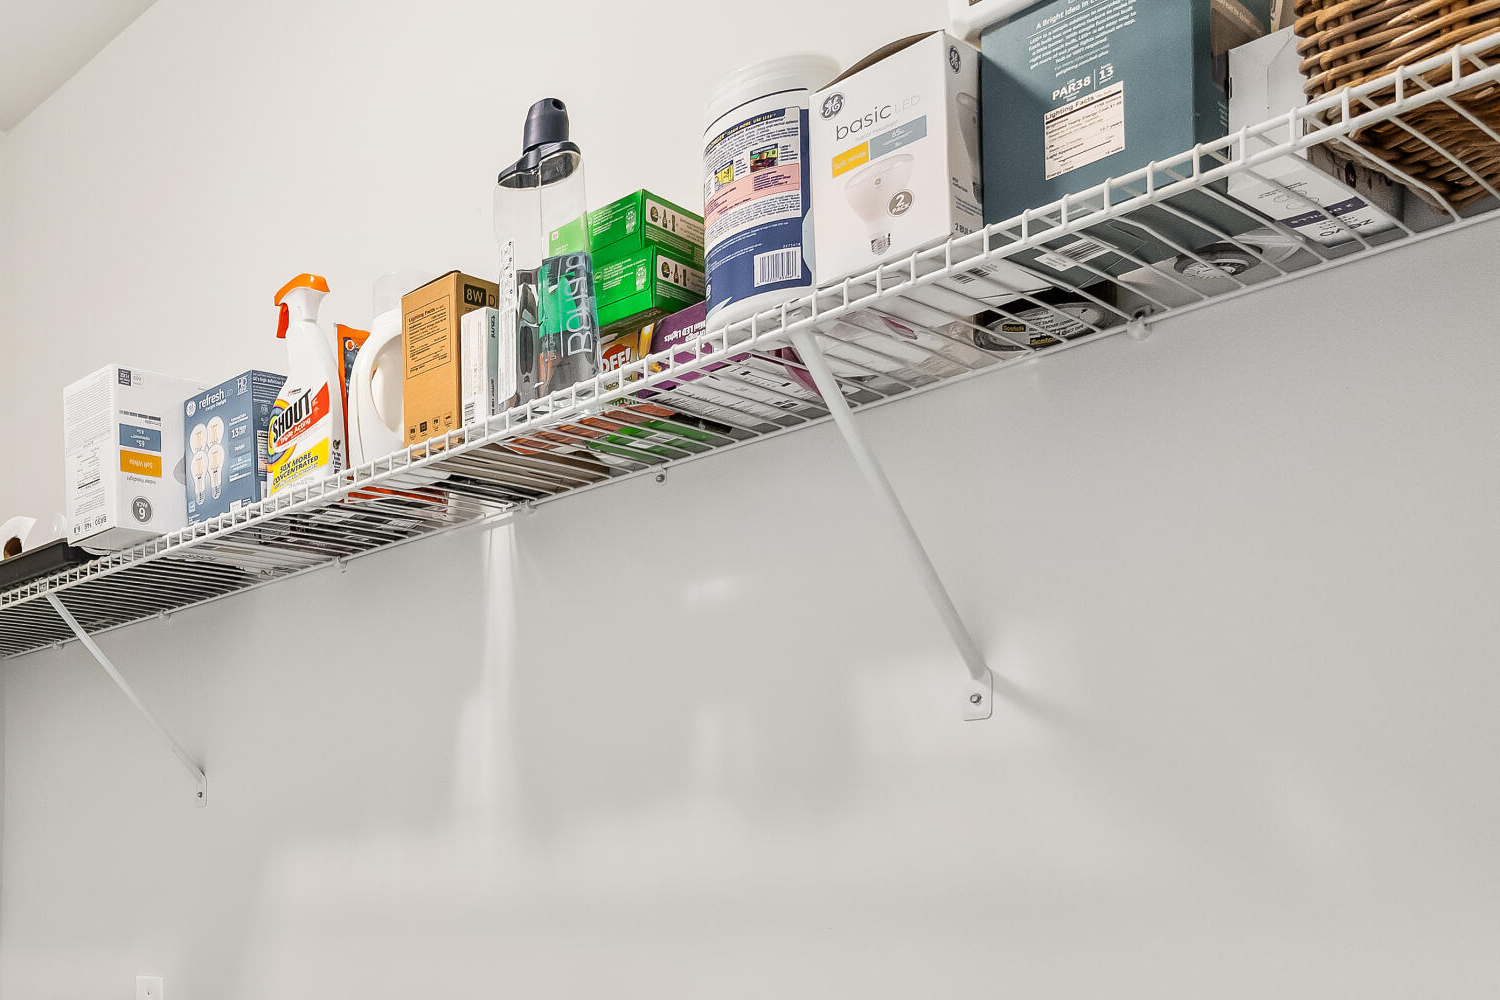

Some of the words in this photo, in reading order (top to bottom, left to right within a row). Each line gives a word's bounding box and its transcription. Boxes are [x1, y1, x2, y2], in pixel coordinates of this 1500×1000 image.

[1042, 14, 1064, 27] Bright
[1065, 6, 1080, 16] Idea
[1053, 76, 1091, 100] PAR38
[1099, 66, 1114, 80] 13
[1046, 105, 1074, 121] Lighting
[1076, 96, 1094, 107] Facts
[836, 105, 892, 141] basic
[894, 94, 921, 114] LED
[895, 195, 905, 207] 2
[892, 204, 910, 215] PACK
[955, 223, 959, 231] 2
[467, 289, 483, 303] 8W
[409, 310, 424, 323] Lighting
[424, 307, 436, 316] Facts
[664, 330, 682, 342] Lights
[682, 325, 694, 336] LED
[199, 388, 224, 410] refresh
[272, 388, 312, 444] SHOUT
[232, 428, 239, 439] 13
[280, 430, 294, 444] Triple
[294, 418, 311, 433] Acting
[129, 458, 143, 467] White
[143, 461, 153, 469] Soft
[292, 452, 312, 468] MORE
[273, 455, 319, 485] CONCENTRATED
[136, 501, 149, 509] PACK
[138, 507, 146, 520] 6
